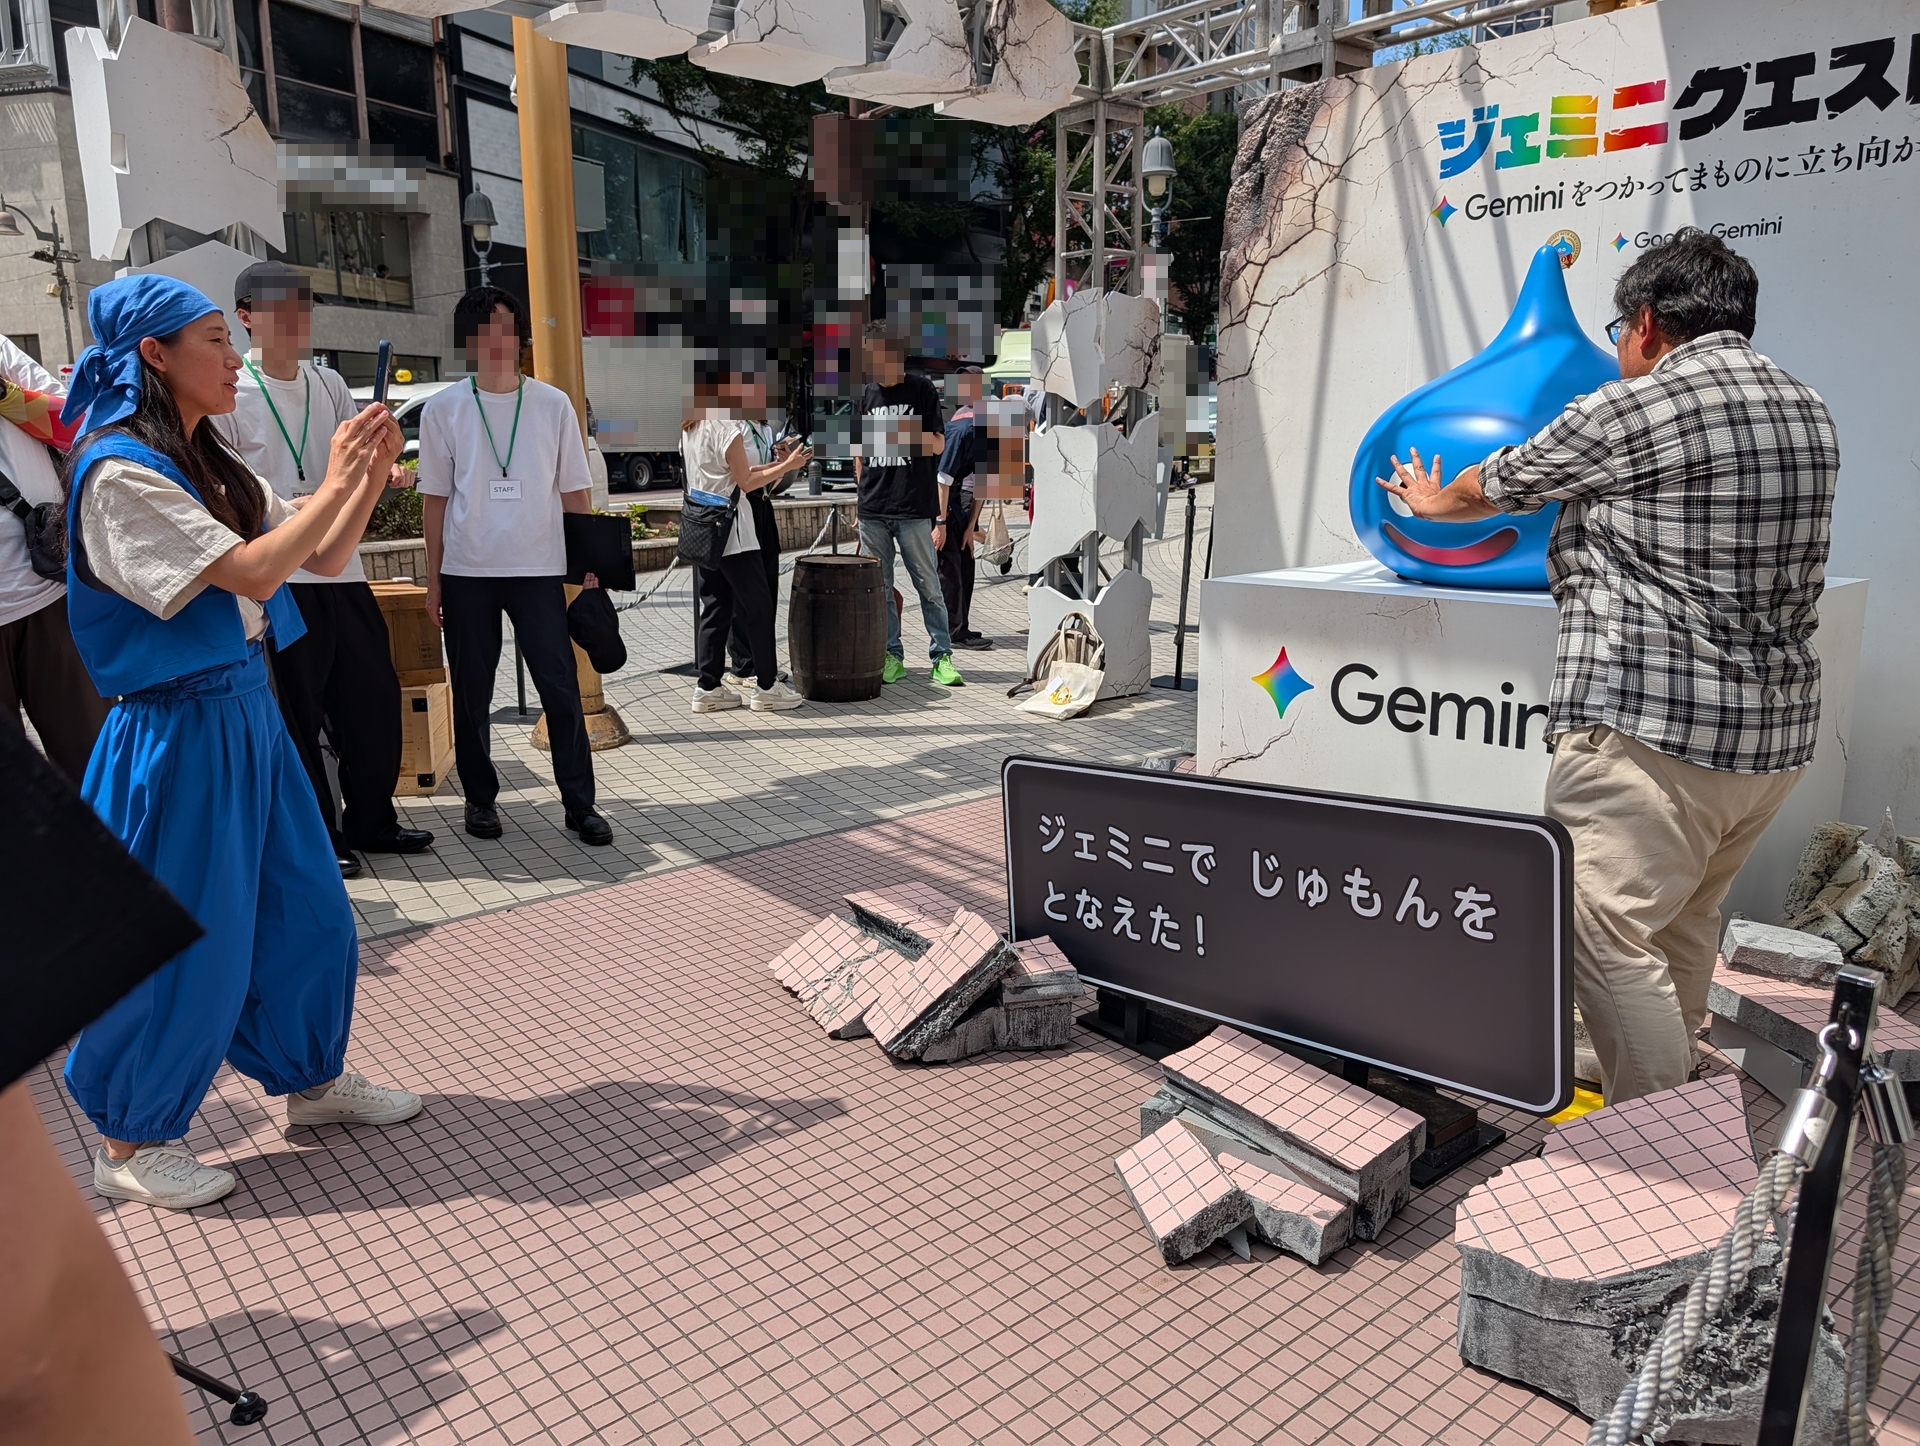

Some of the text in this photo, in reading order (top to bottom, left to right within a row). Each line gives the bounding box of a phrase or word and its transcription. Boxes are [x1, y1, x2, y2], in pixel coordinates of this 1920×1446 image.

[1465, 135, 1920, 221] Gemini をつかってまものに立ち向か
[1710, 216, 1783, 239] Gemini
[1331, 663, 1554, 754] Gemin
[1039, 814, 1497, 940] ジェミニで じゅもんを
